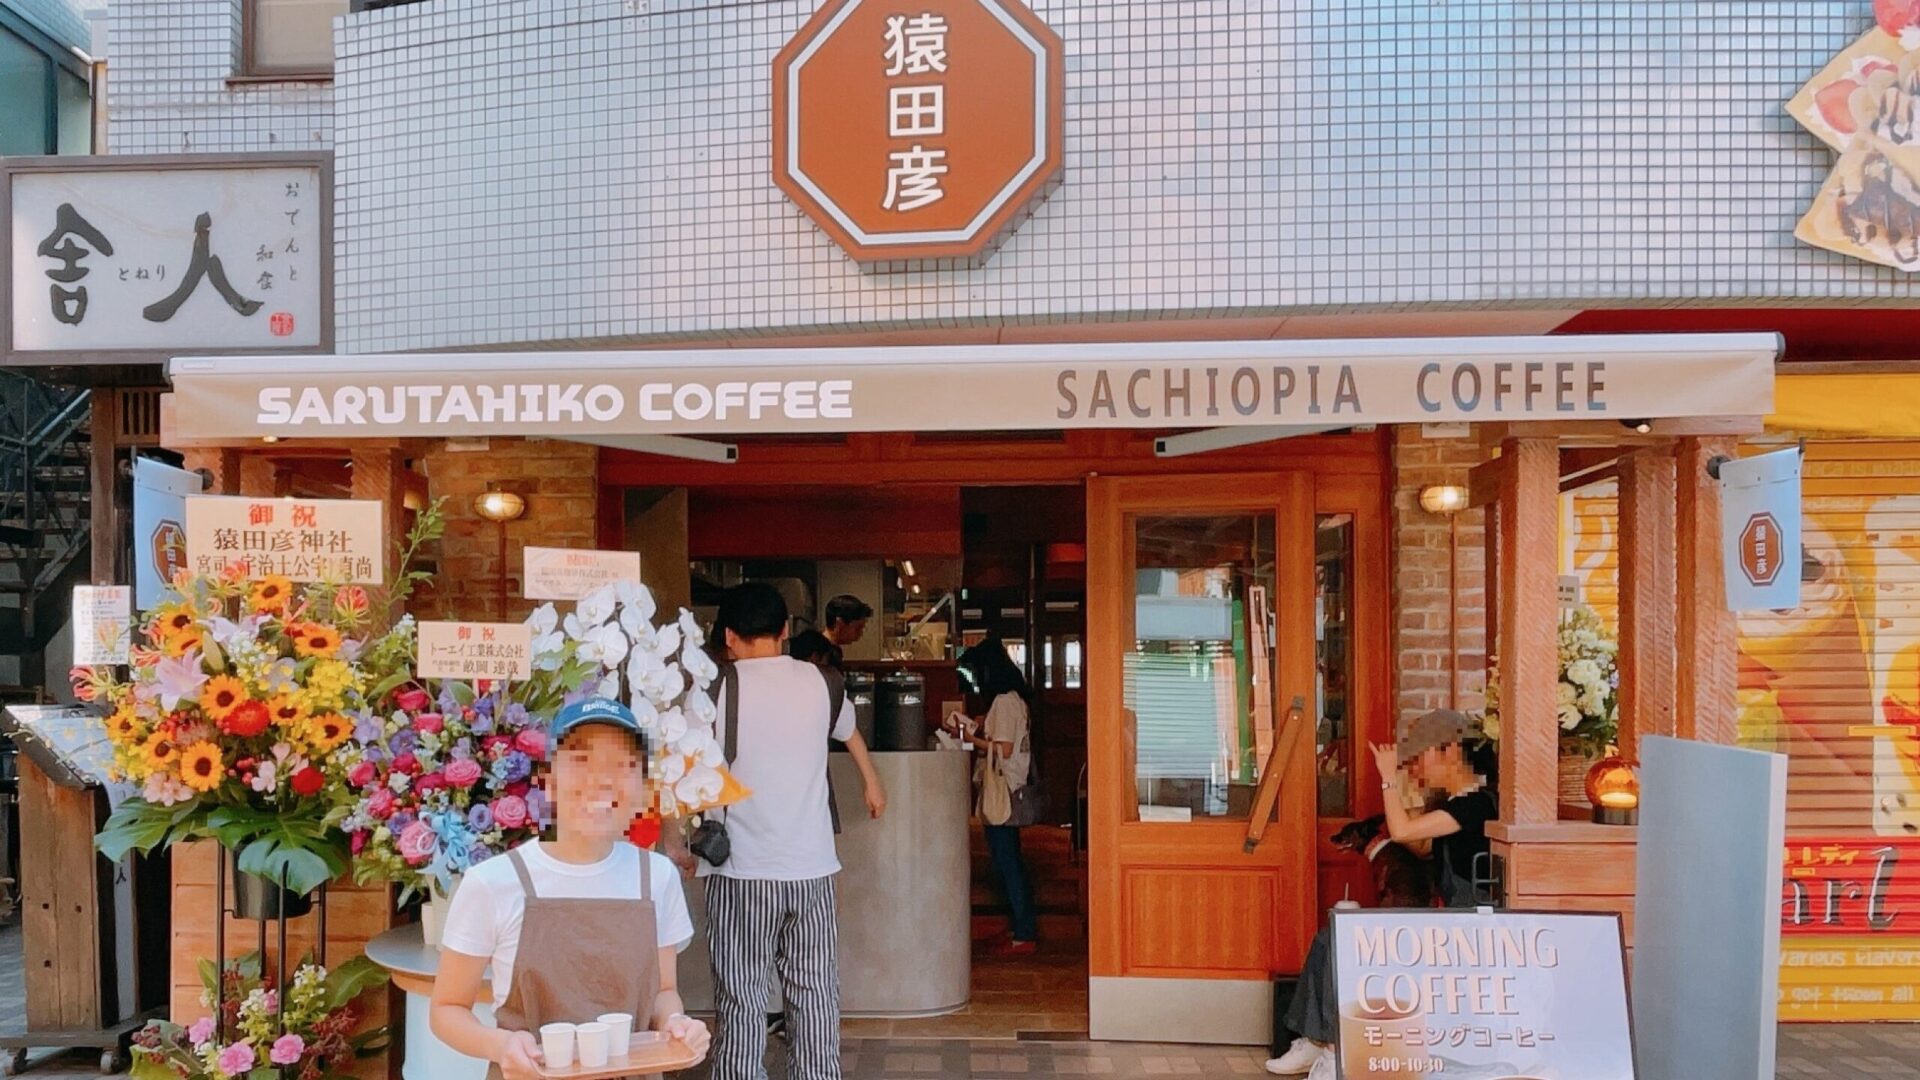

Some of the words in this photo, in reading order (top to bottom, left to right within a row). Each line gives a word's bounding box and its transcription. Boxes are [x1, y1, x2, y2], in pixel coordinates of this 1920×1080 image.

[883, 13, 948, 211] 猿田彦
[37, 202, 265, 326] 舎人
[119, 264, 166, 281] とねり
[257, 385, 624, 425] SARUTAHIKO
[639, 380, 853, 420] COFFEE
[1056, 365, 1362, 418] SACHIOPIA
[1416, 362, 1606, 412] COFFEE
[249, 504, 317, 528] 御祝
[213, 528, 353, 554] 猿田彦神社
[1355, 925, 1560, 968] MORNING
[1356, 972, 1520, 1016] COFFEE
[1364, 1025, 1555, 1048] モーニングコーヒー
[1368, 1056, 1444, 1073] 8:00-10:30
